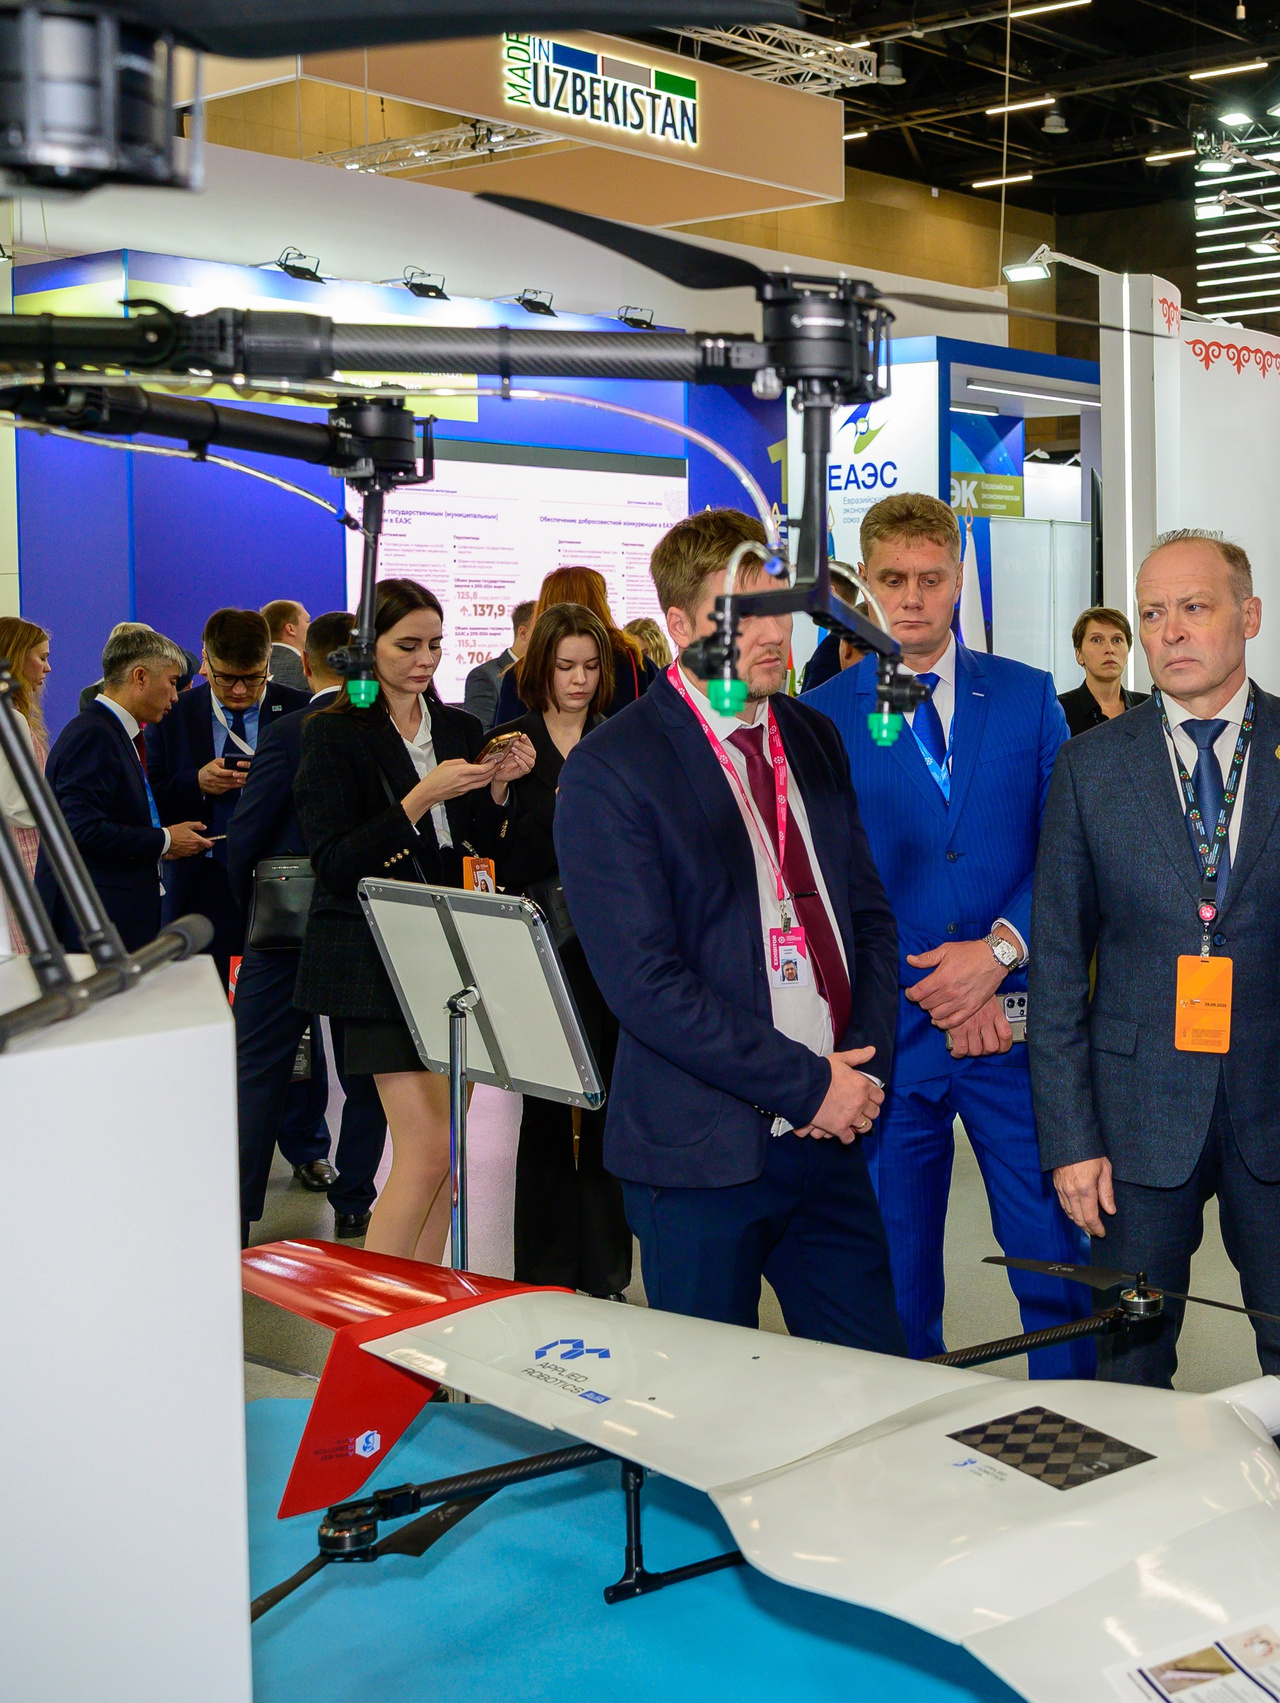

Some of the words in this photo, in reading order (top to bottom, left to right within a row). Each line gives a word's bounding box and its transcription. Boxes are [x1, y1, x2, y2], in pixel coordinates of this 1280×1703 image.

[504, 31, 531, 105] MADE
[532, 36, 550, 63] IN
[533, 61, 698, 144] UZBEKISTAN
[828, 461, 898, 491] ЕАЭС
[388, 508, 444, 517] государственным
[539, 516, 577, 524] Обеспечение
[457, 592, 478, 600] 125,8
[472, 604, 506, 619] 137,9
[521, 1367, 584, 1394] ROBOTICS
[536, 1362, 588, 1383] APPLIED
